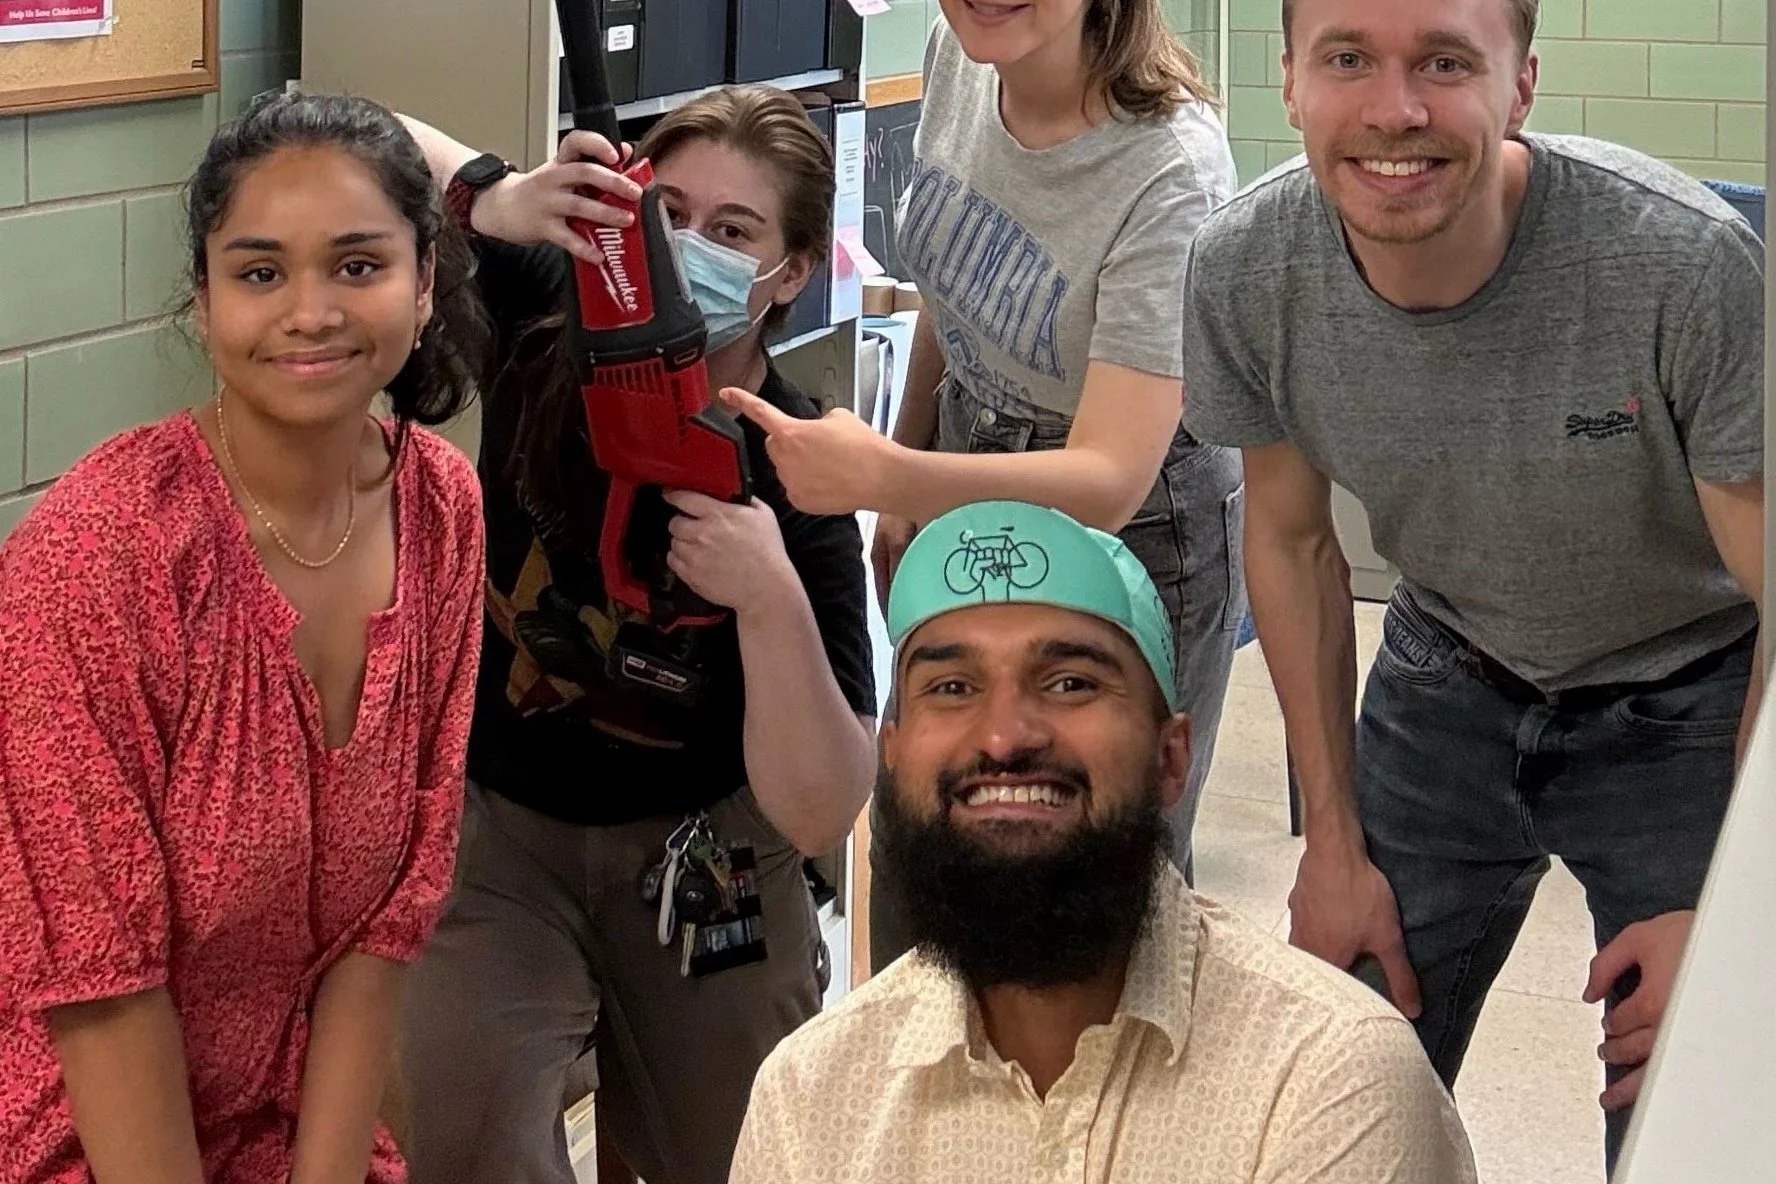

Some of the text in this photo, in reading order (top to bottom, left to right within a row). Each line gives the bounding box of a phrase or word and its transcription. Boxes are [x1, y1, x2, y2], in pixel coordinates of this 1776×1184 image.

[9, 10, 24, 21] Help
[34, 8, 50, 17] Save
[595, 227, 638, 312] Milwaukee
[896, 158, 1069, 383] OLUMBIA
